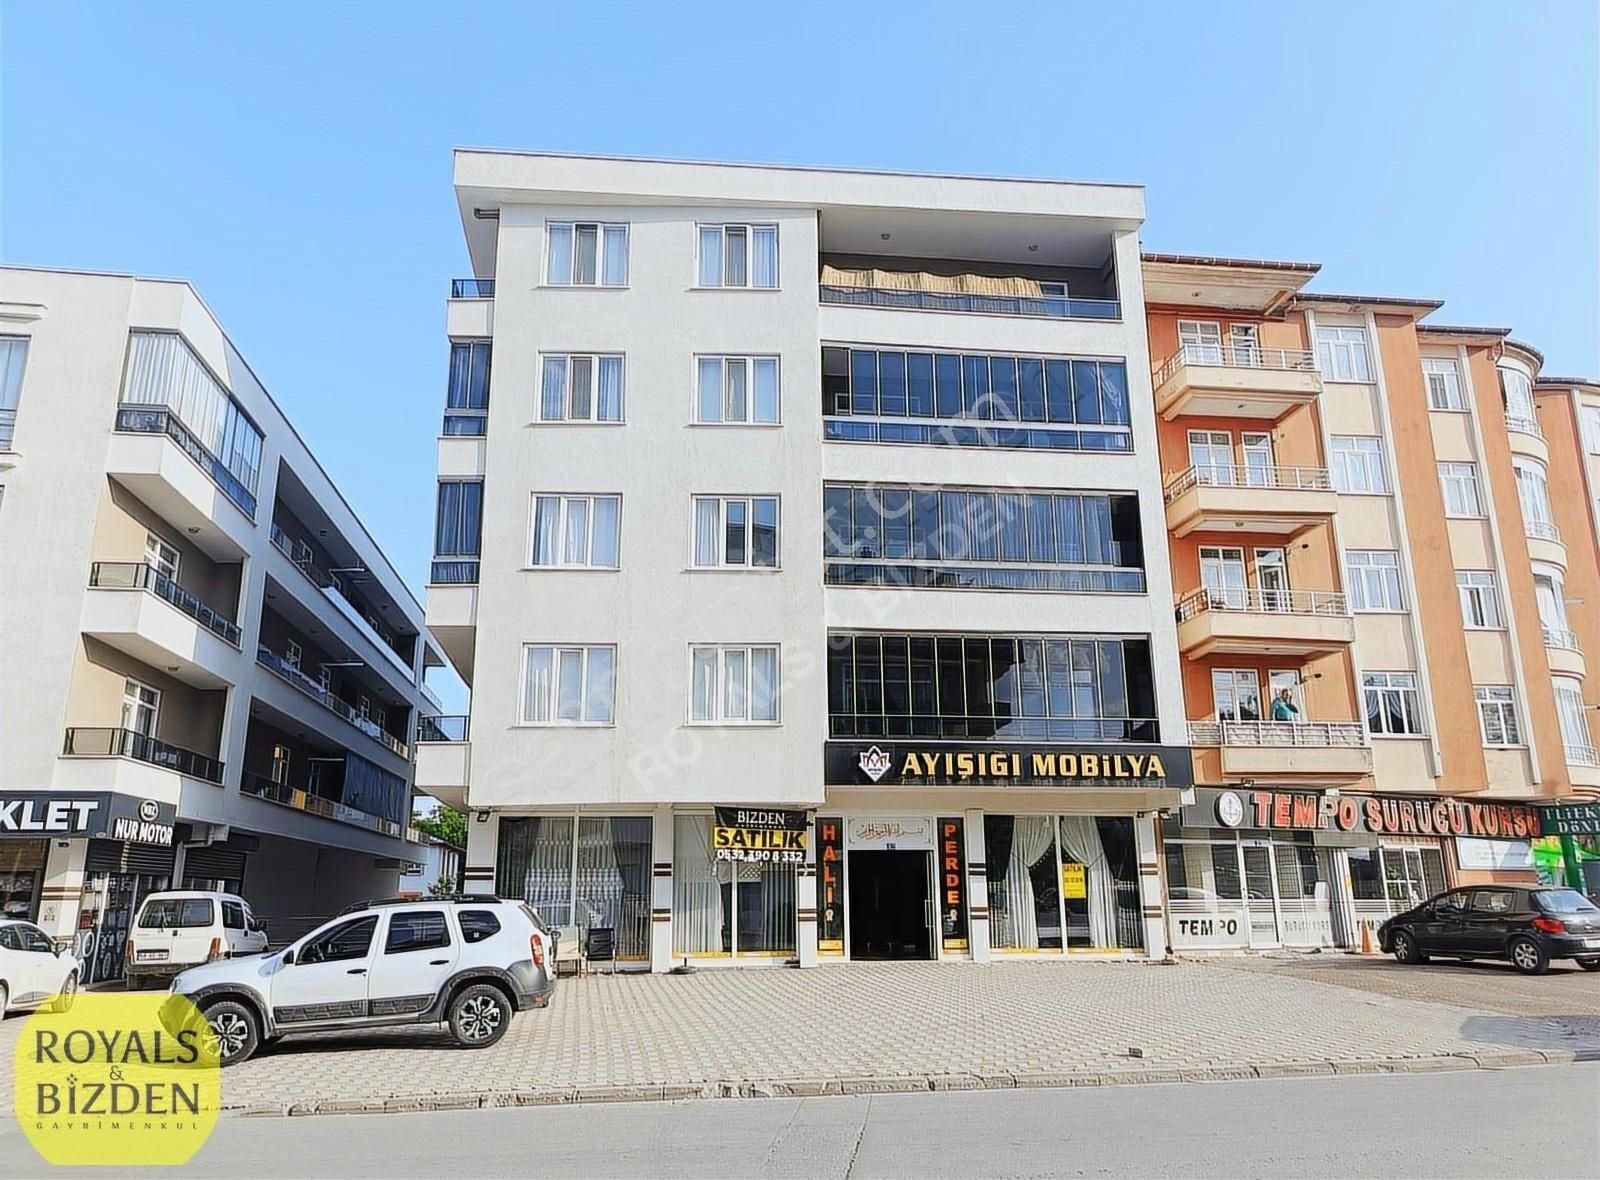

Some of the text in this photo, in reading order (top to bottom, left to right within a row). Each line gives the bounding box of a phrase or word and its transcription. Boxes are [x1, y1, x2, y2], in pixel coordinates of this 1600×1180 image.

[1253, 792, 1358, 831] TEMPO
[115, 818, 173, 845] NUR MOTOR
[716, 829, 805, 849] SATILIK
[944, 824, 960, 904] PERDE
